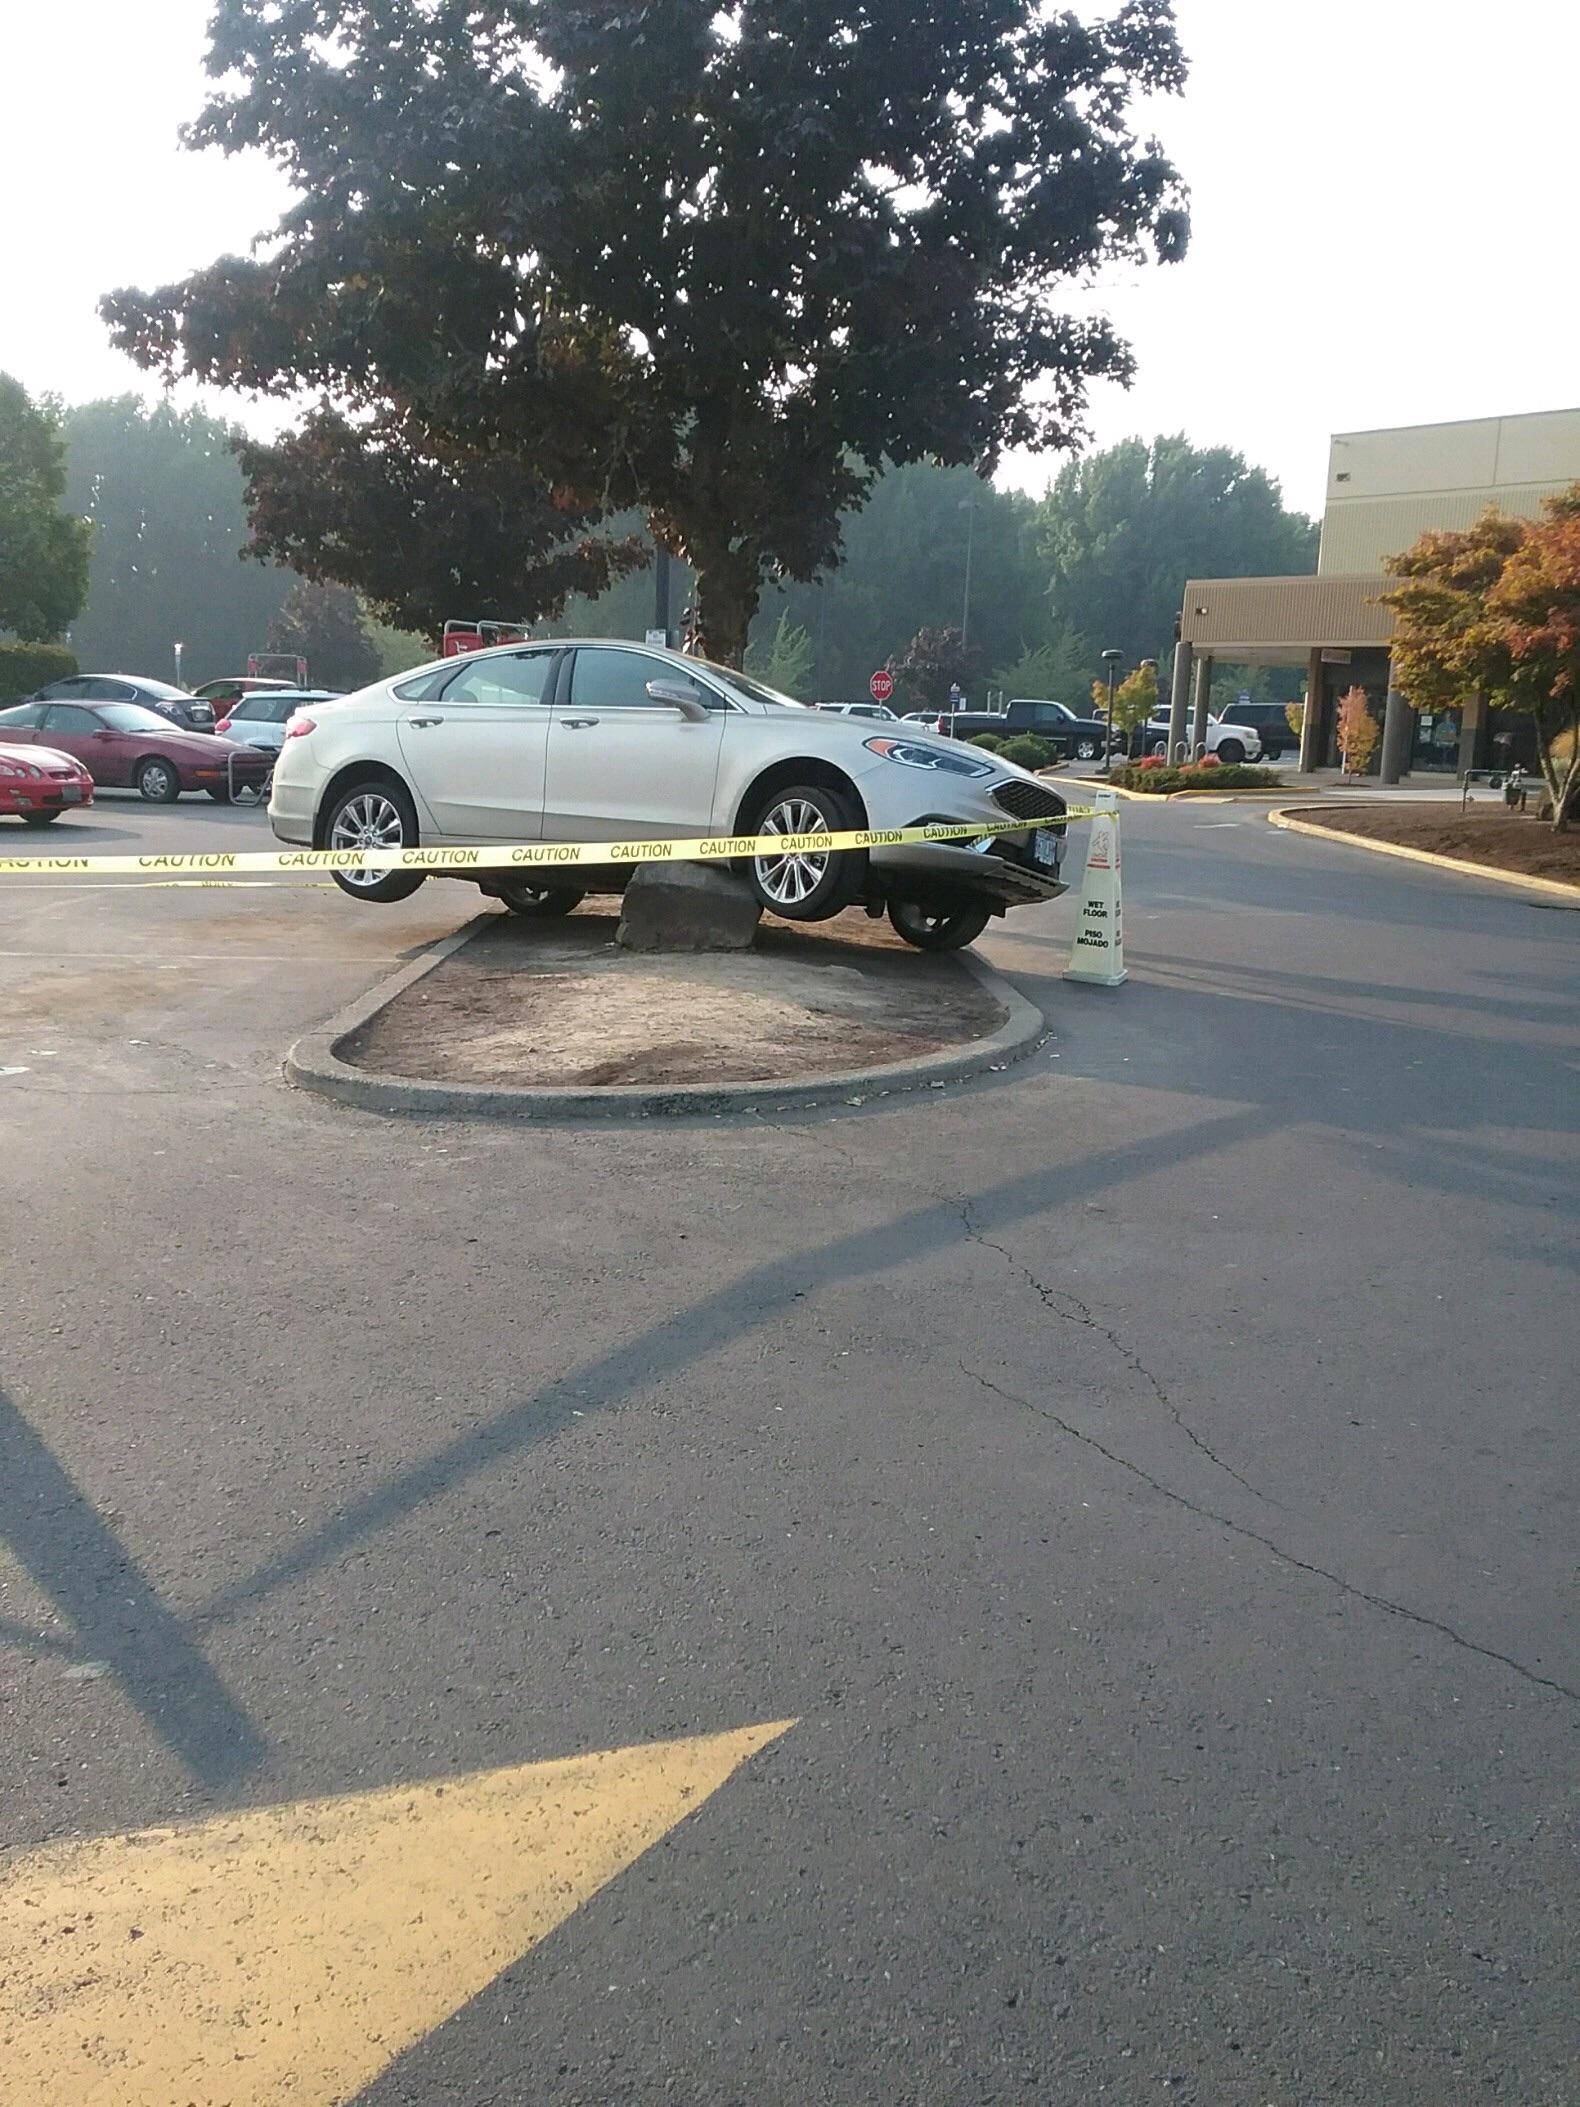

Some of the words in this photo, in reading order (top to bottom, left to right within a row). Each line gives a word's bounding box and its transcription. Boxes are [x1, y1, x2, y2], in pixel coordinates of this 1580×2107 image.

[872, 680, 891, 692] STOP
[0, 859, 88, 868] AUTION
[138, 854, 235, 867] CAUTION
[278, 852, 365, 866] CAUTION
[402, 849, 480, 865] CAUTION
[511, 847, 580, 862] CAUTION
[610, 843, 672, 859] CAUTION
[699, 839, 756, 855] CAUTION
[780, 834, 833, 851] CAUTION
[855, 830, 903, 845] CAUTION
[923, 825, 968, 839] CAUTION
[1088, 901, 1104, 909] WET
[1083, 909, 1108, 918] FLOOR
[1085, 930, 1103, 938] PISO
[1077, 937, 1109, 948] MOJADO
